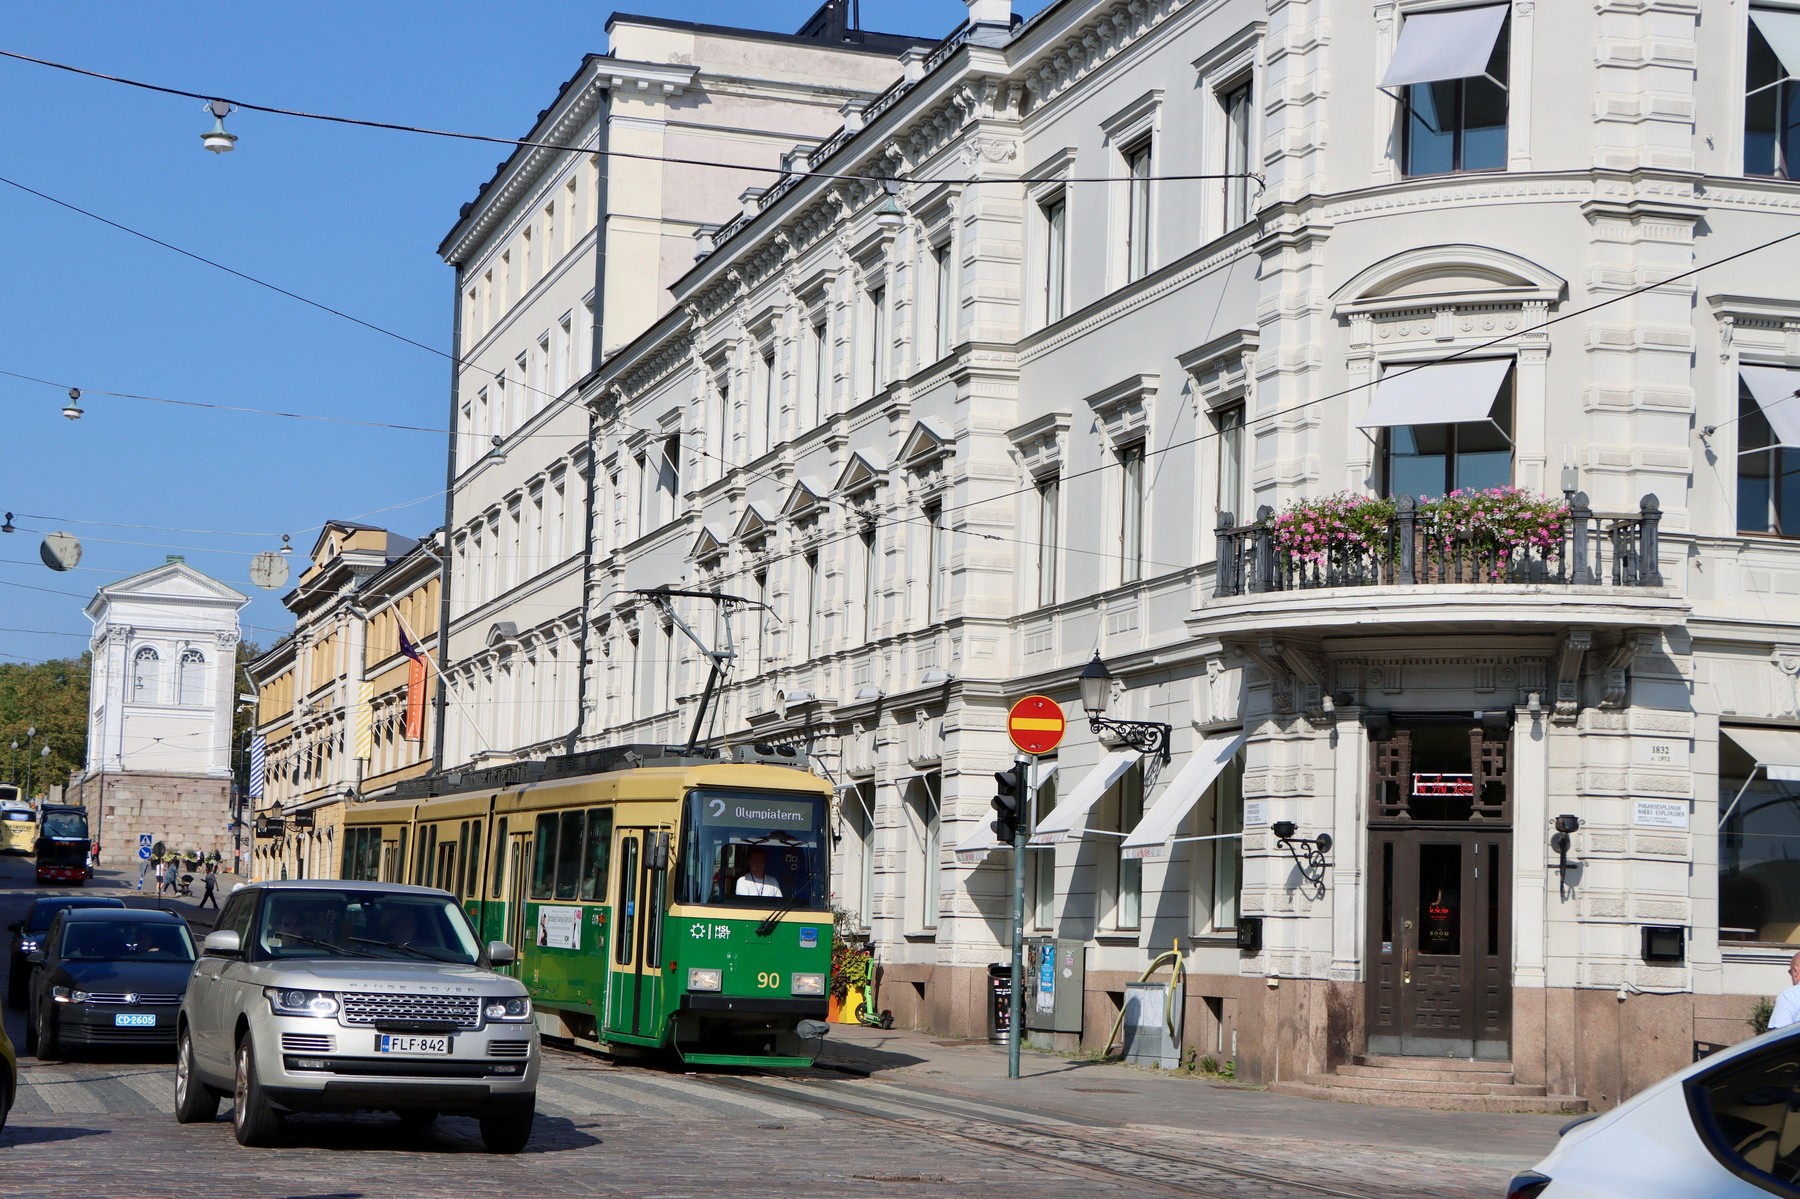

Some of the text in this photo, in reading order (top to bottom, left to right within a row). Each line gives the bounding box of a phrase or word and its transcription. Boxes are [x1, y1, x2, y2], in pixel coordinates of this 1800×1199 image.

[1652, 746, 1670, 754] 1832
[709, 798, 804, 821] 2 Olympiaterm.
[714, 925, 731, 933] HSL
[714, 932, 731, 940] HRT
[757, 971, 780, 989] 90
[419, 985, 475, 993] ROVER
[118, 1015, 154, 1025] CD-2605
[391, 1038, 445, 1052] FLF-842
